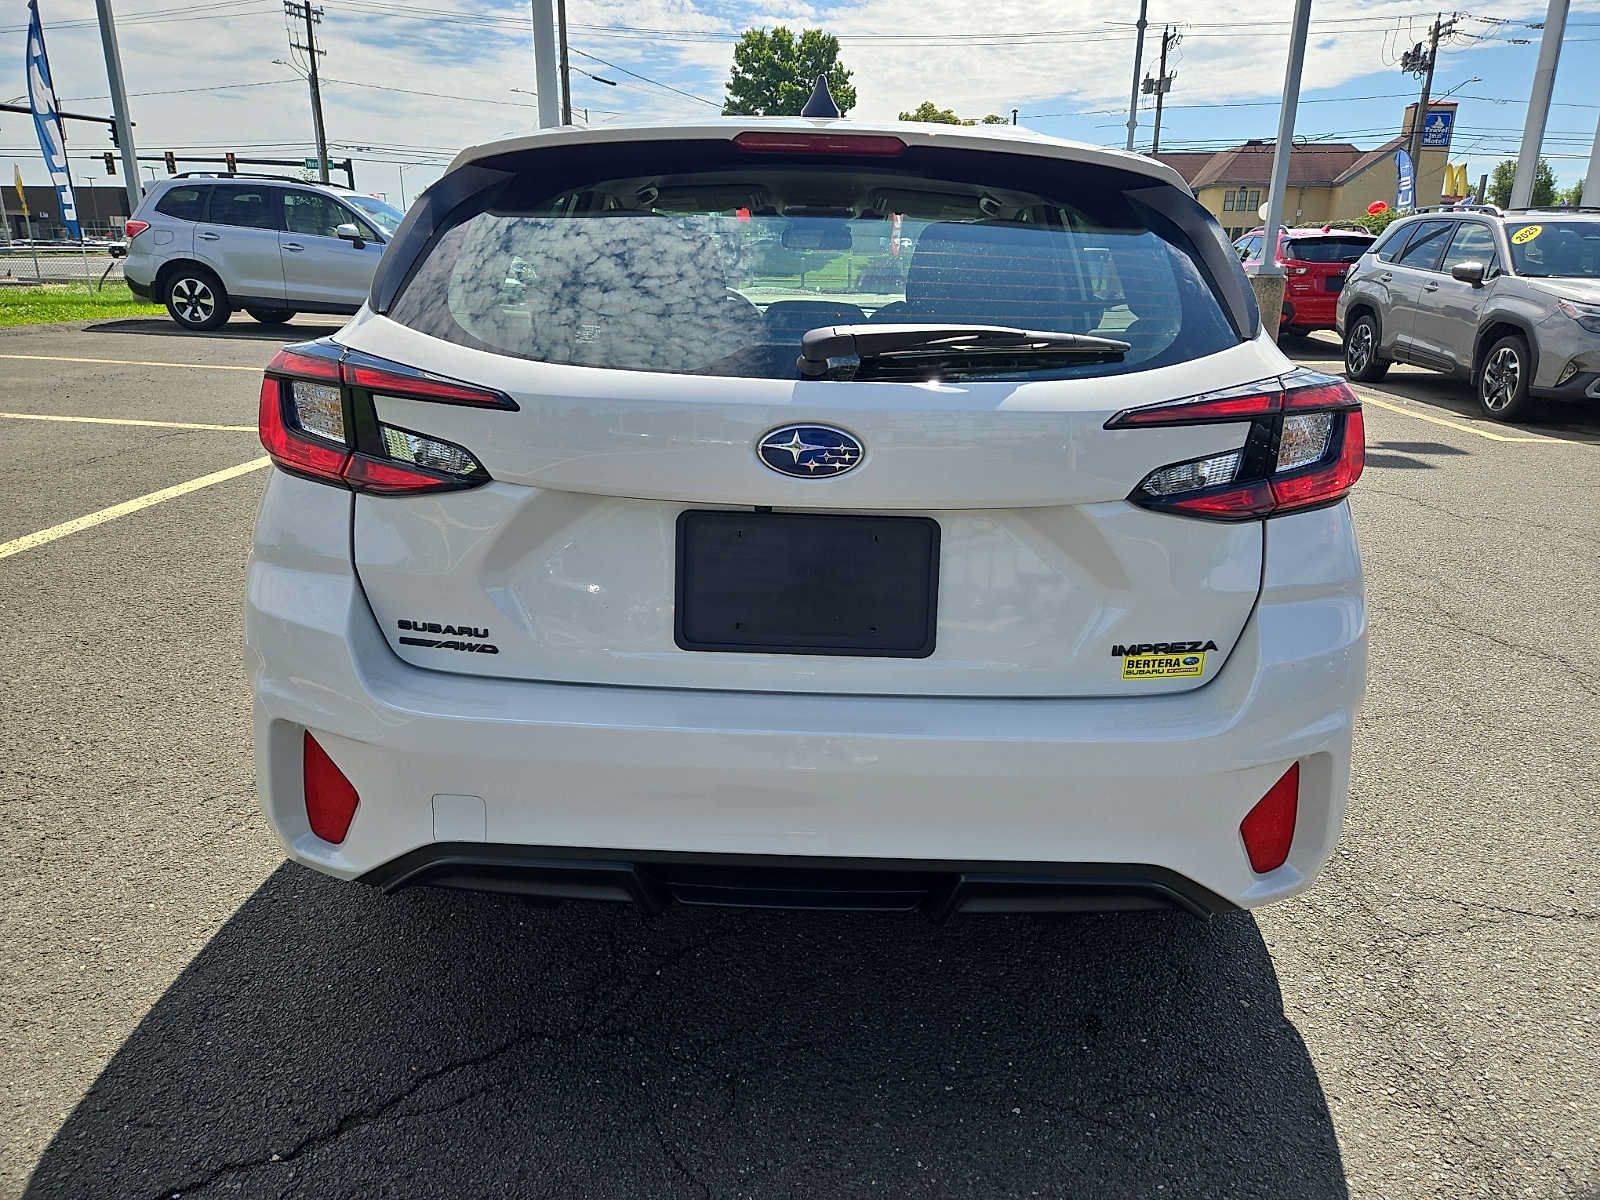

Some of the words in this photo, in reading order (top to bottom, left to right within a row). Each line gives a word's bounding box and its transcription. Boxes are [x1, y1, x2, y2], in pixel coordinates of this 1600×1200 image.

[1516, 226, 1538, 242] 2025
[397, 619, 489, 638] SUBARU
[435, 640, 499, 655] AWD
[1111, 640, 1218, 656] IMPREZA
[1127, 658, 1180, 669] BERTERA
